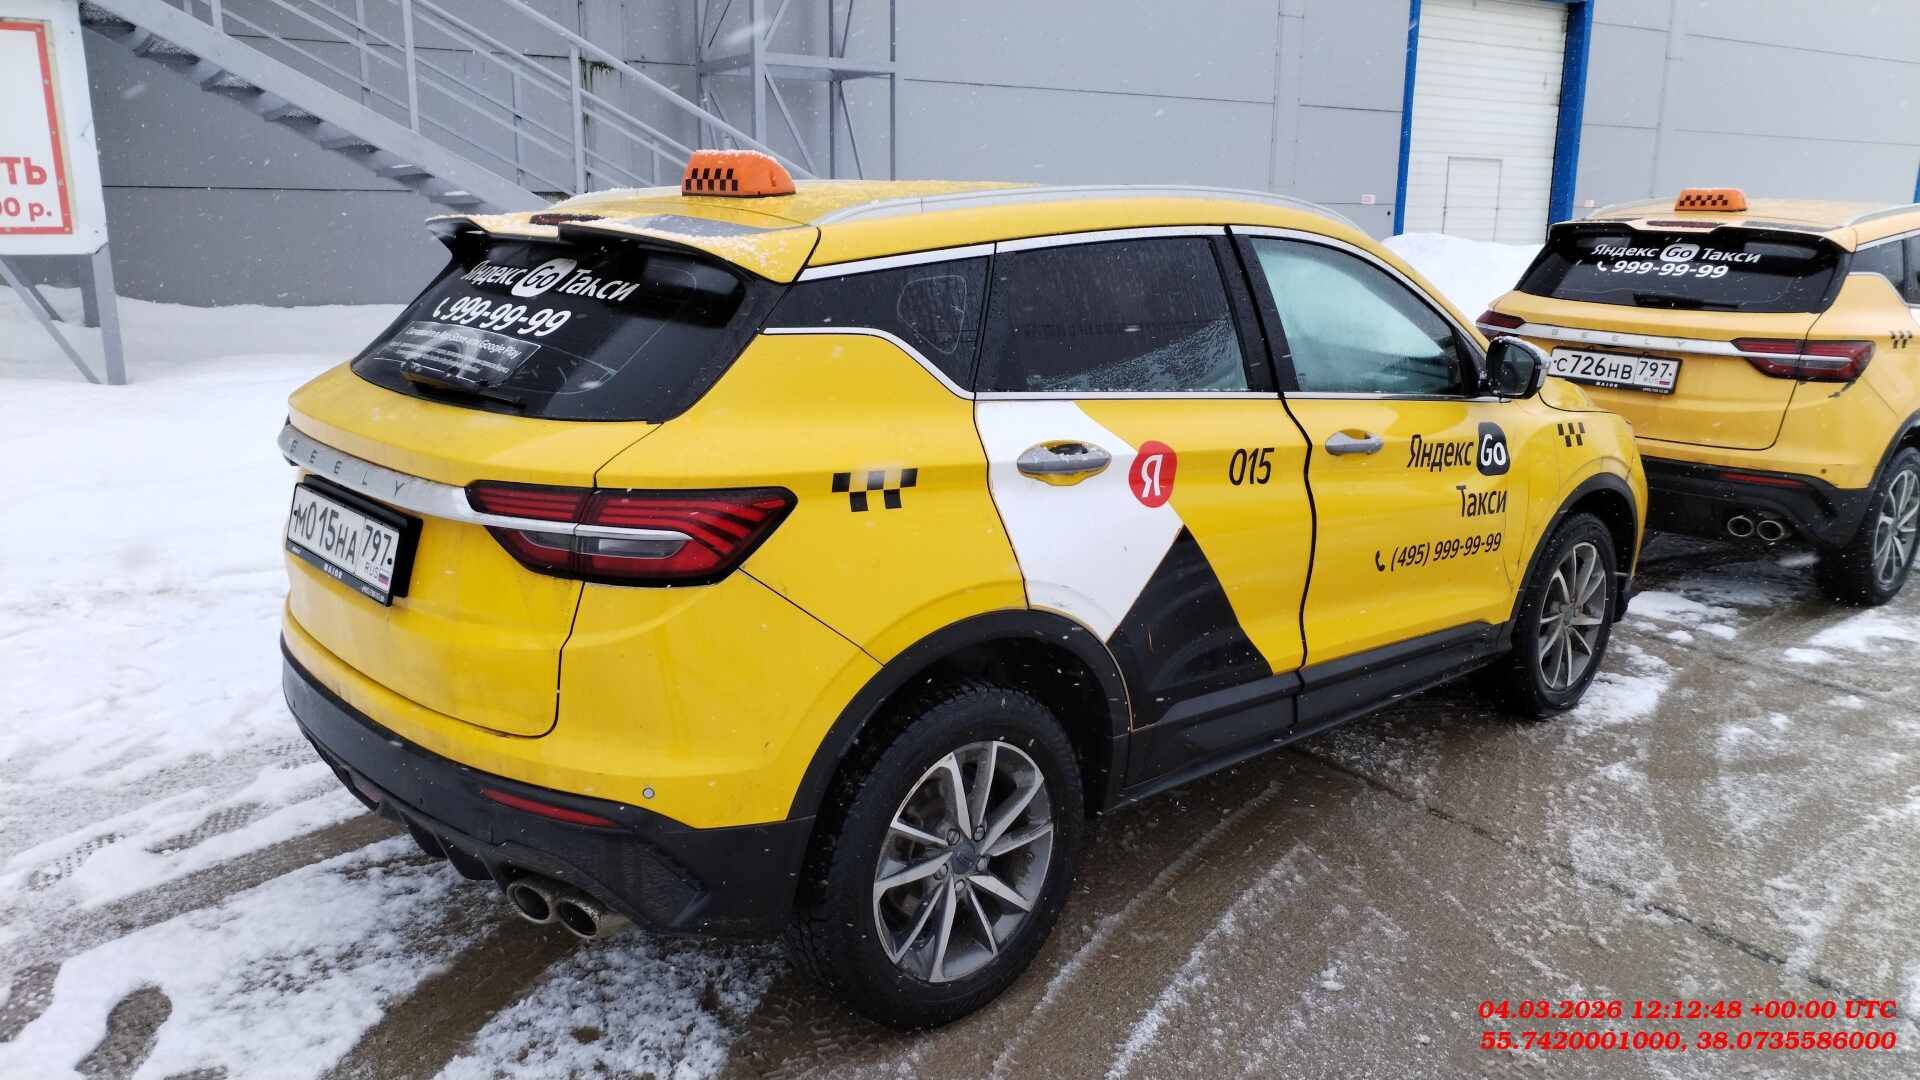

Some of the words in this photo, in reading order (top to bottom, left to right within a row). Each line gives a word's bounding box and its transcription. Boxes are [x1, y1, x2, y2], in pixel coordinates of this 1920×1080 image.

[0, 156, 48, 185] ТЬ
[0, 197, 20, 217] 0
[28, 202, 52, 222] р.
[1591, 243, 1659, 257] Яндекс
[1702, 248, 1762, 263] Такси
[1611, 260, 1729, 279] 999-99-99
[460, 260, 528, 286] Яндекс
[558, 268, 641, 301] Такси
[444, 296, 572, 337] 999-99-99
[1556, 354, 1633, 380] С726НВ
[1639, 361, 1669, 378] 797
[1229, 448, 1275, 486] 015
[1407, 434, 1474, 472] Яндекс
[1480, 433, 1508, 467] Go
[1141, 453, 1162, 498] Я
[1456, 485, 1508, 517] Такси
[295, 501, 357, 565] М015НА
[362, 524, 392, 566] 797
[1391, 543, 1430, 572] (495)
[1433, 532, 1502, 562] 999-99-99
